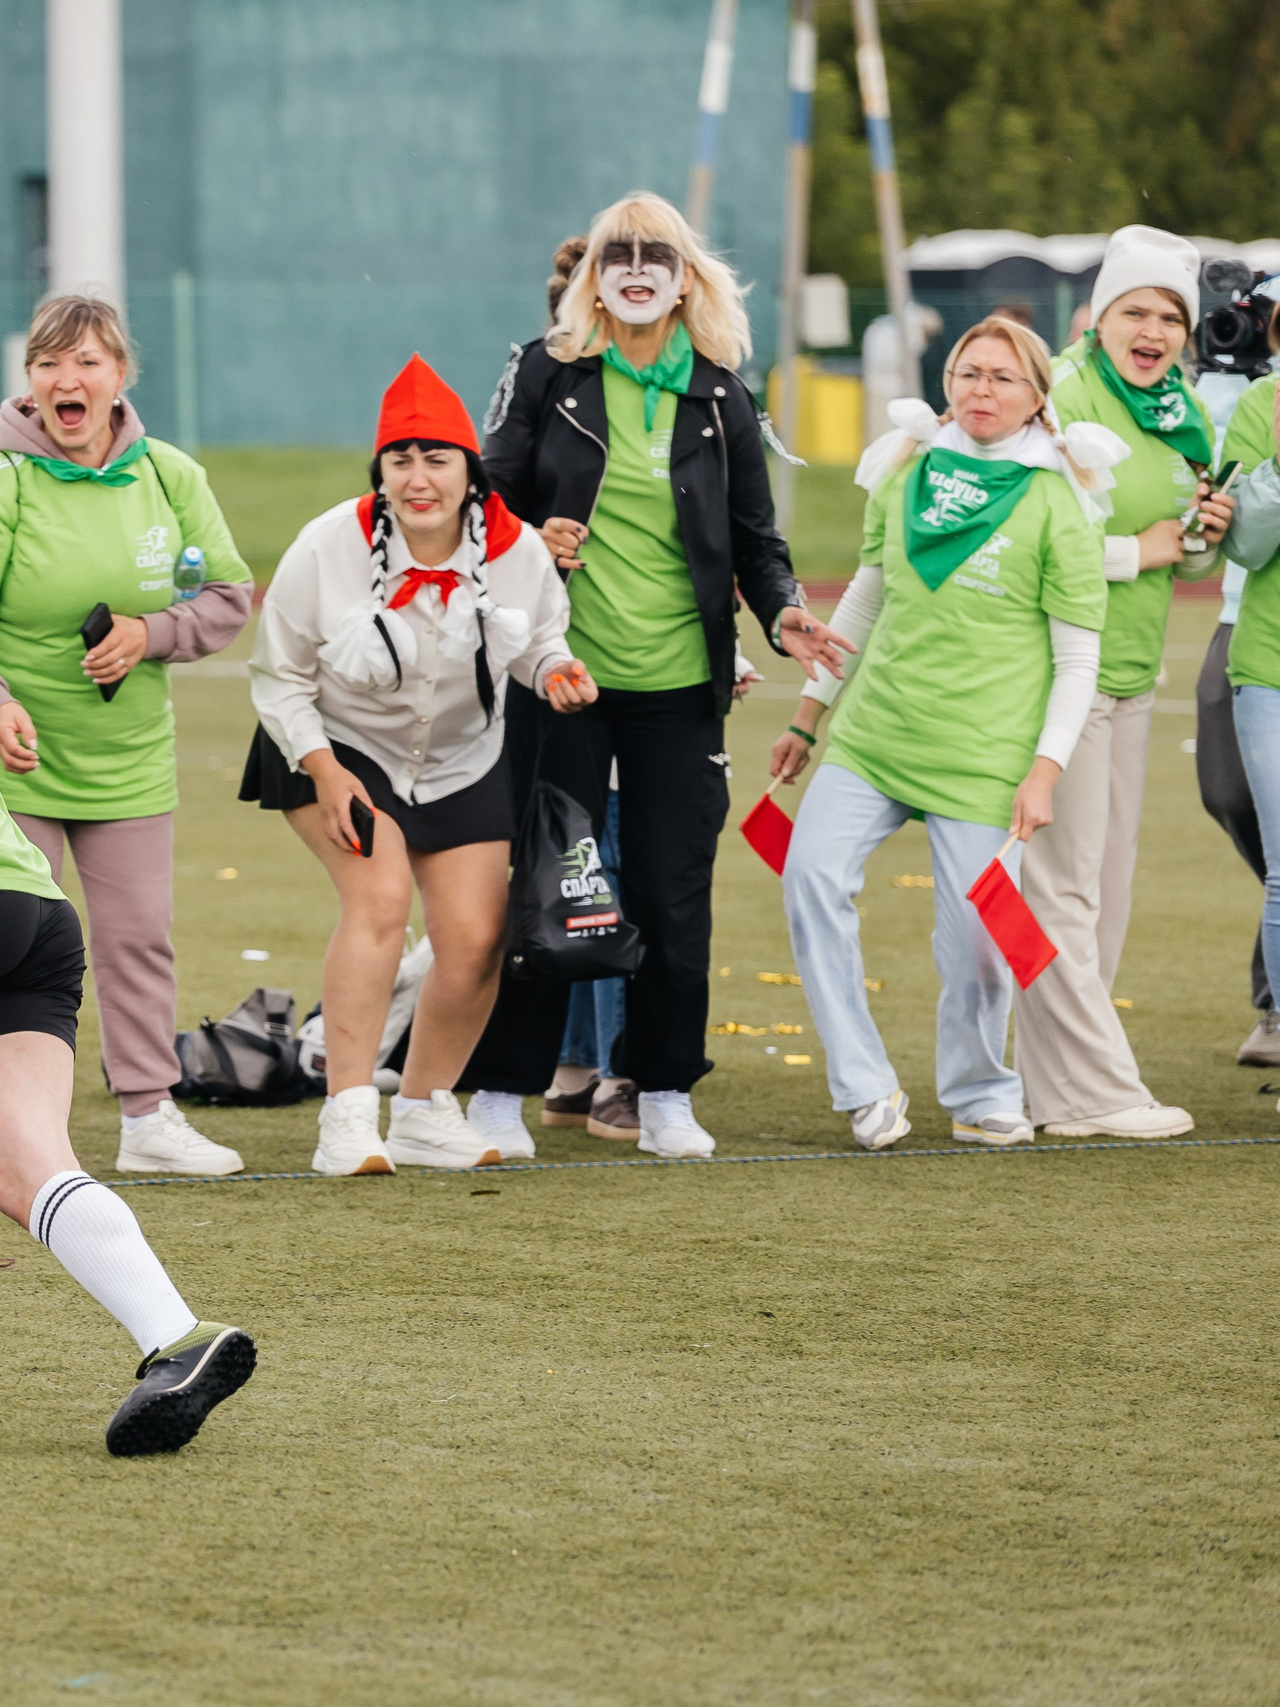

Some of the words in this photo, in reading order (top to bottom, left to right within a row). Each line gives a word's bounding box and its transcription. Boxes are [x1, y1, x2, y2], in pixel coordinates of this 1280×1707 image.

[928, 471, 988, 504] СПАРТА
[965, 554, 1000, 572] АРТА
[560, 875, 610, 898] СПАРТА
